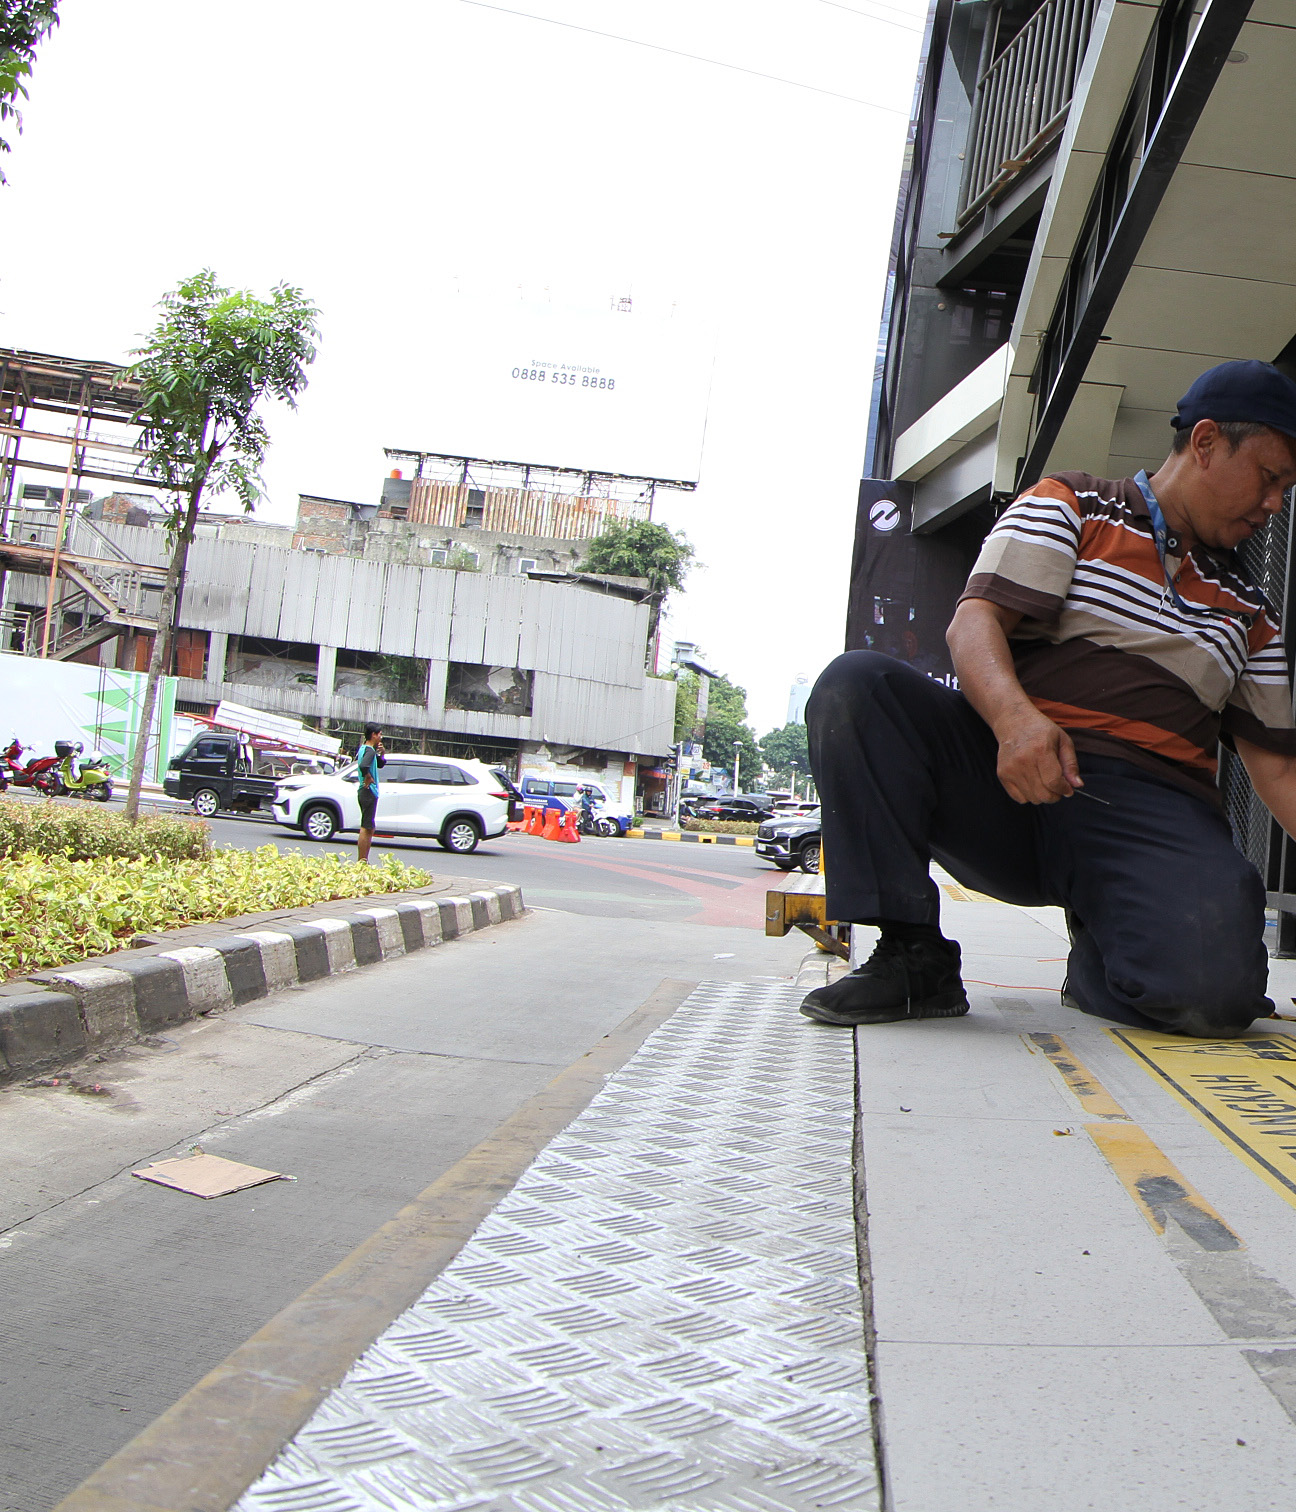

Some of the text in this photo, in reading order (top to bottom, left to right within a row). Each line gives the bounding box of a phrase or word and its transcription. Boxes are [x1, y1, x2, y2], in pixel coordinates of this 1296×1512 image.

[531, 359, 600, 374] Space Available
[512, 367, 615, 390] 0888 535 8888
